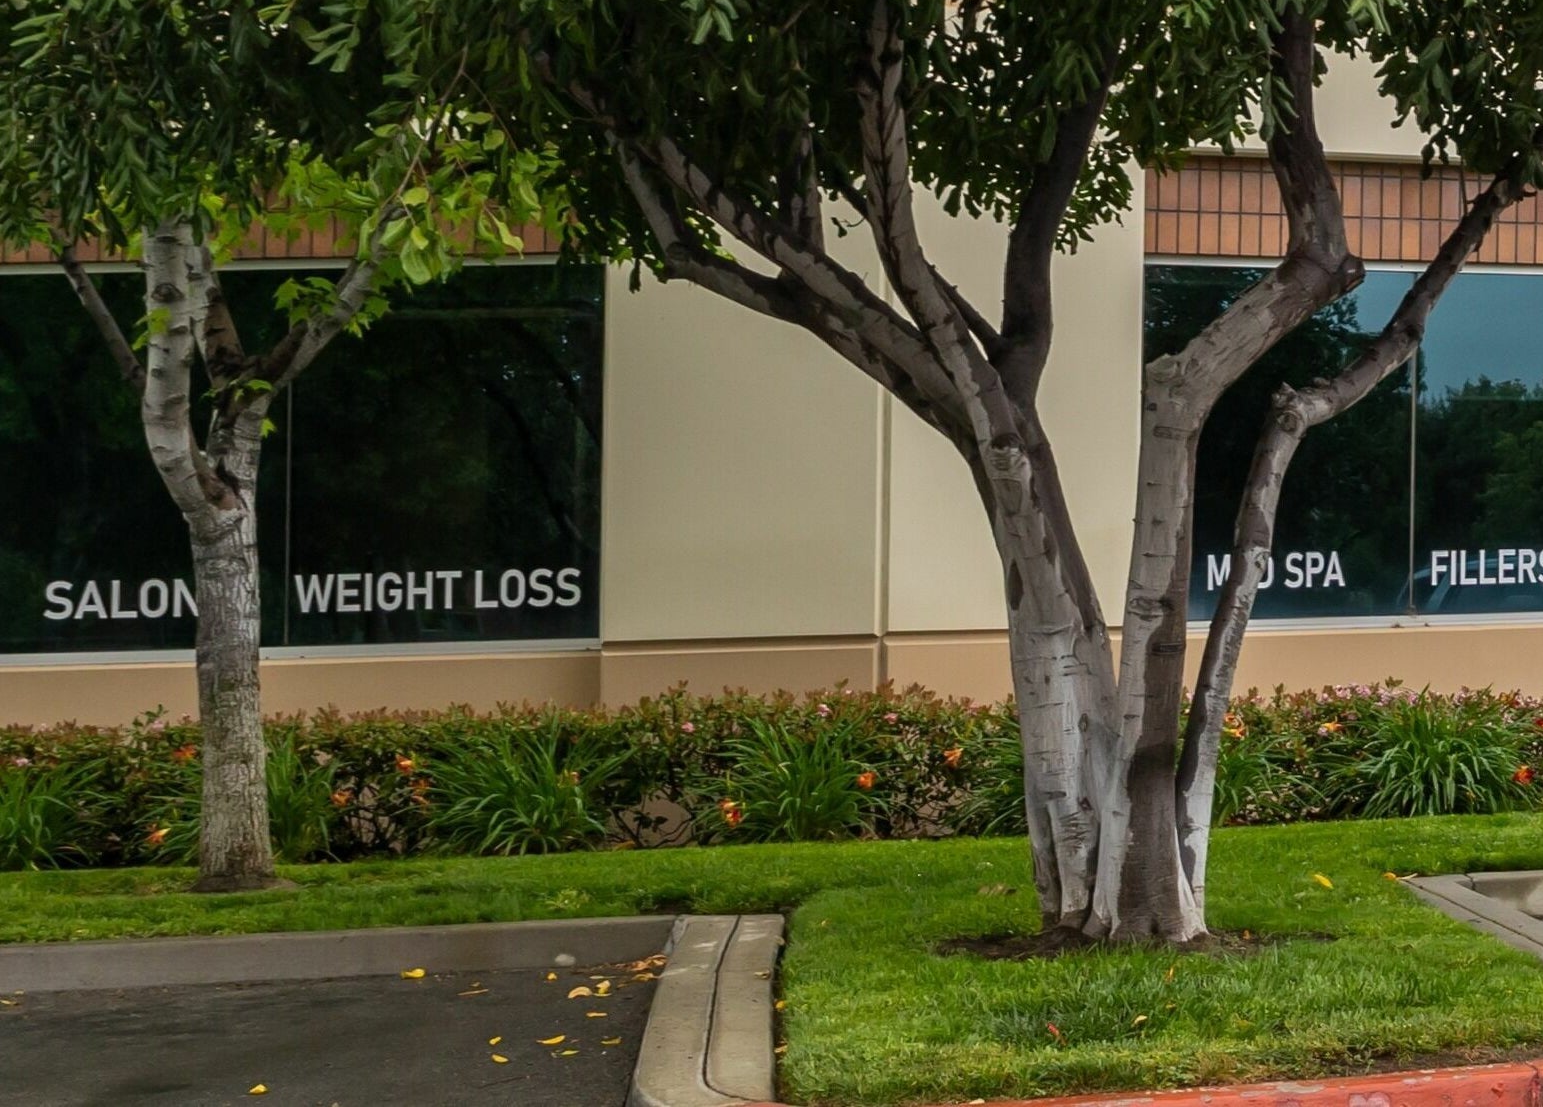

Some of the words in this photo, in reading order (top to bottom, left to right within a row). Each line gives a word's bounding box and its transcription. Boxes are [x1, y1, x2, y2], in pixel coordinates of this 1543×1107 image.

[293, 570, 463, 614] WEIGHT
[474, 567, 582, 610] LOSS
[1206, 553, 1275, 592] MD
[1283, 550, 1346, 589] SPA
[42, 578, 199, 621] SALON
